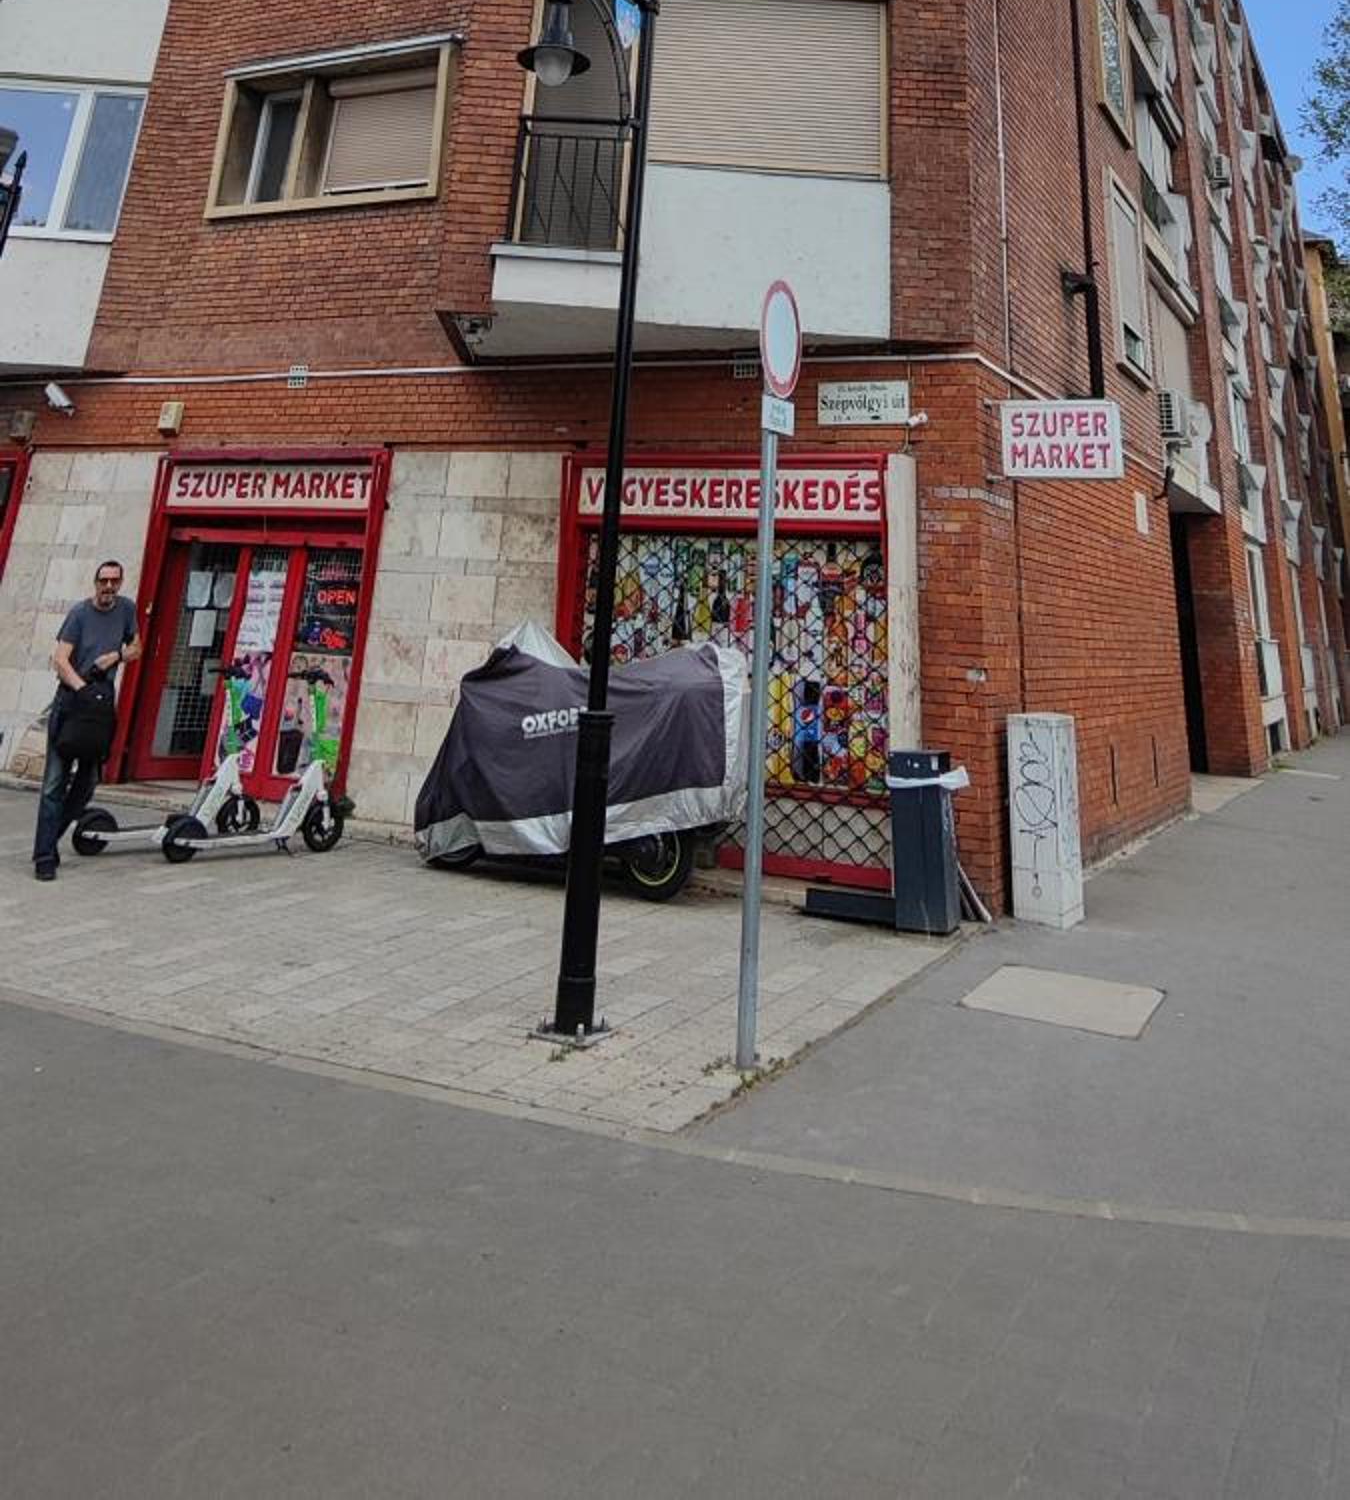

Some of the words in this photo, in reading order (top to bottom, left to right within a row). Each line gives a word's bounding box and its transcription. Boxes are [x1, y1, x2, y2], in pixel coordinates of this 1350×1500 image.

[1011, 410, 1107, 437] SZUPER
[1010, 442, 1111, 469] MARKET
[176, 471, 267, 498] SZUPER
[271, 472, 373, 499] MARKET
[586, 472, 881, 511] VGYESKEREKEDÉS
[317, 589, 355, 605] OPEN
[521, 705, 588, 733] OXFOR
